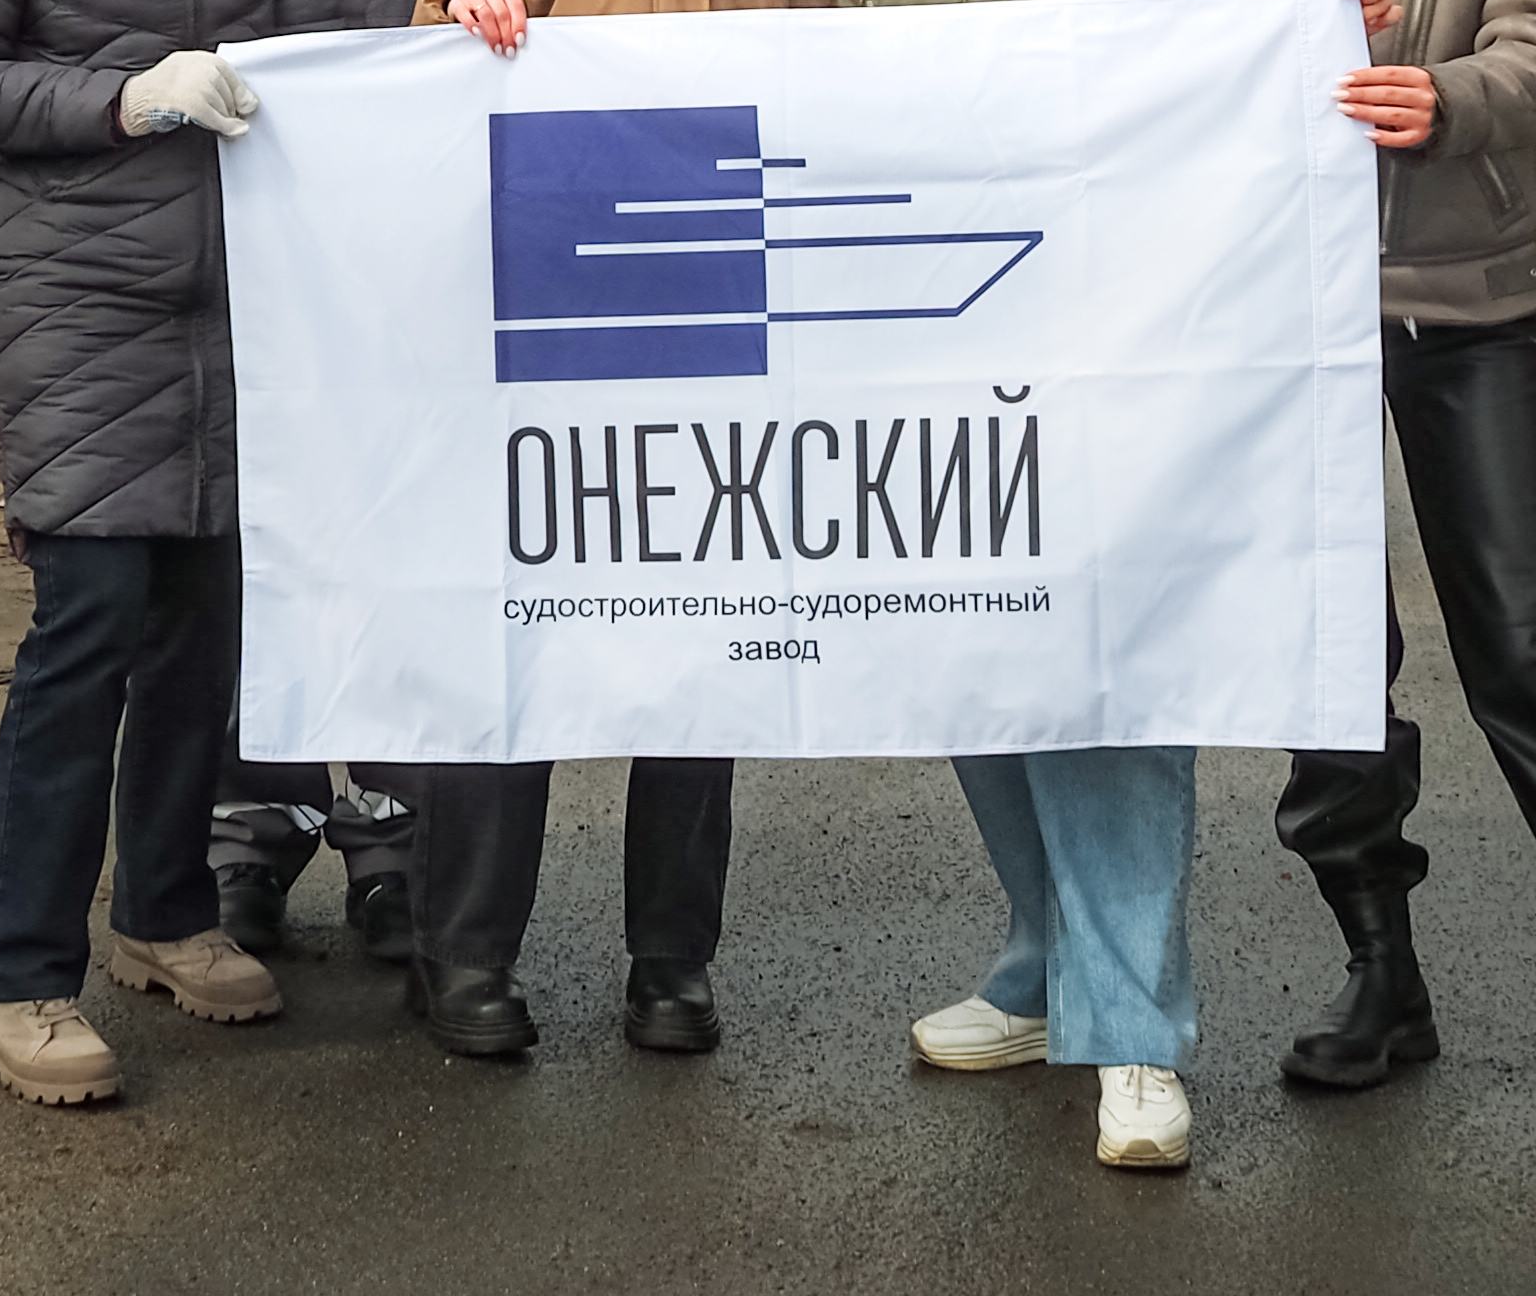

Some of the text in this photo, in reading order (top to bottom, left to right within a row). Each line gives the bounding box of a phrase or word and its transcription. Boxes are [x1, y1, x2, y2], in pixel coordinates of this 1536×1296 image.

[507, 385, 1041, 565] ОНЕЖСКИЙ
[503, 585, 1051, 624] судостроительно-судоремонтный
[727, 637, 821, 664] завод
